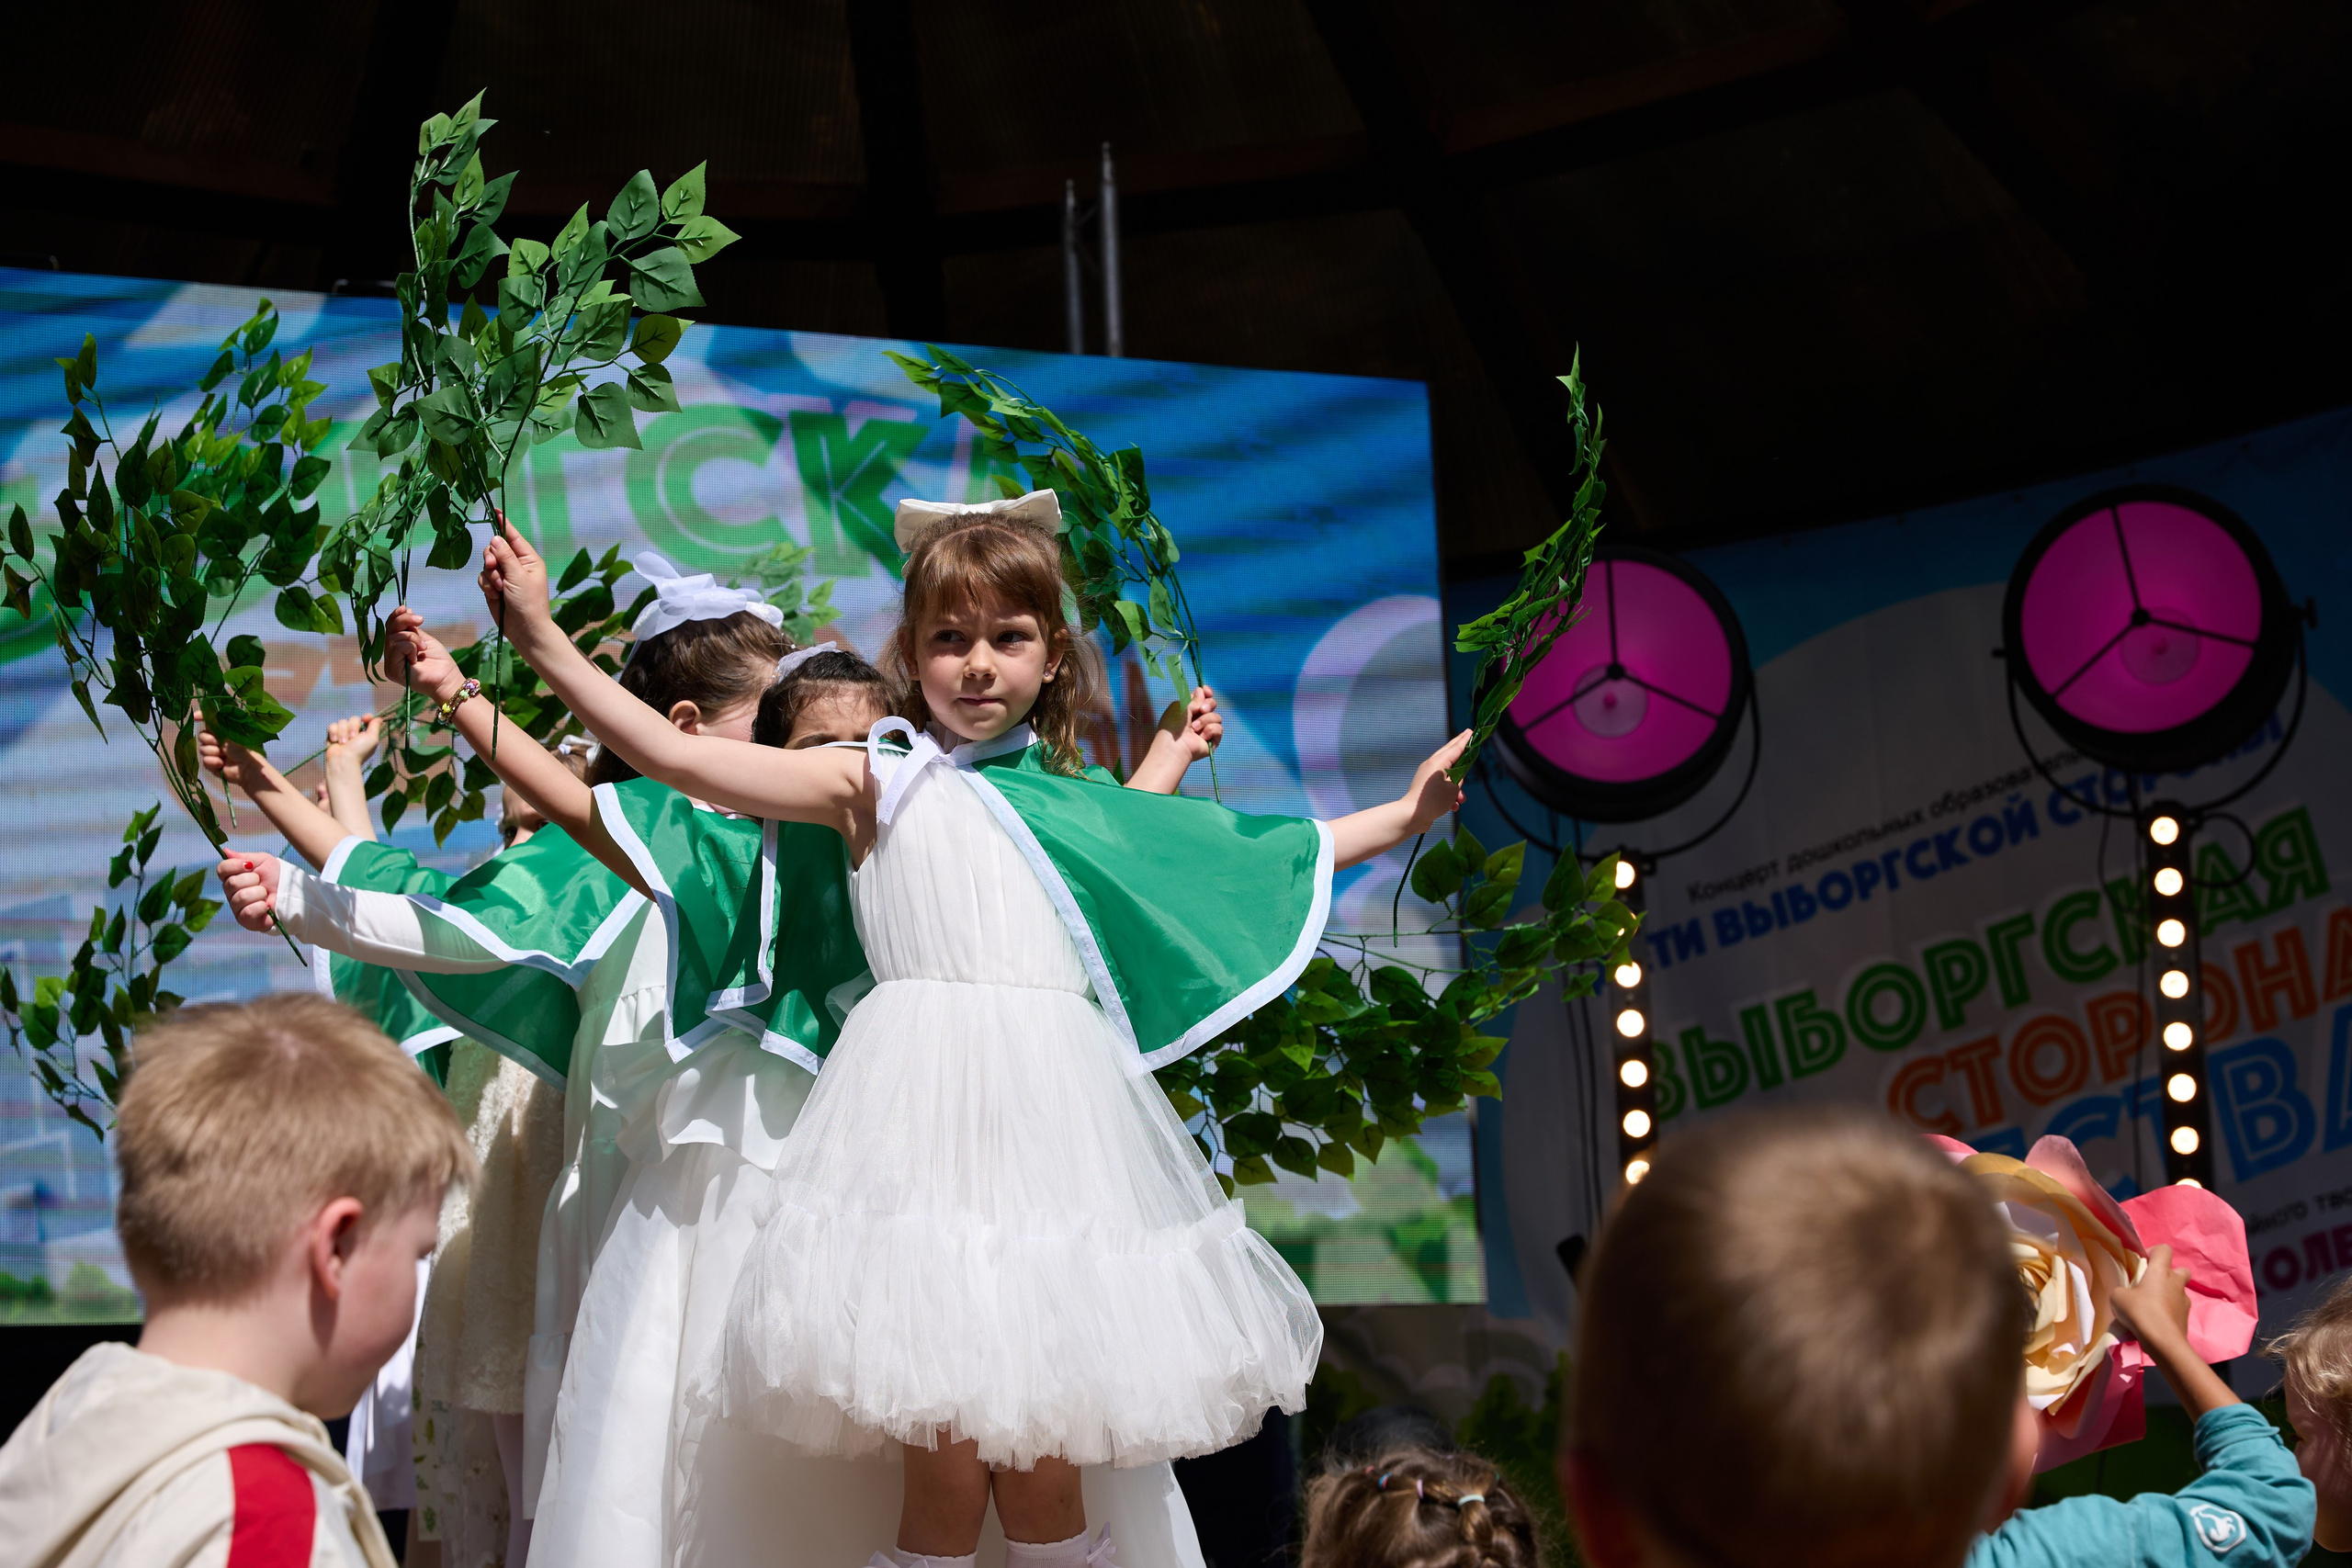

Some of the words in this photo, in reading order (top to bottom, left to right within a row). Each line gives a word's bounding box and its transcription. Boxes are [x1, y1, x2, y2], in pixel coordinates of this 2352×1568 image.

[1688, 860, 1781, 904] Концерт
[1787, 807, 1926, 874] дошкольных
[1713, 794, 2040, 947] ВЫБОРГСКОЙ
[2250, 1224, 2352, 1297] ОЛЕ
